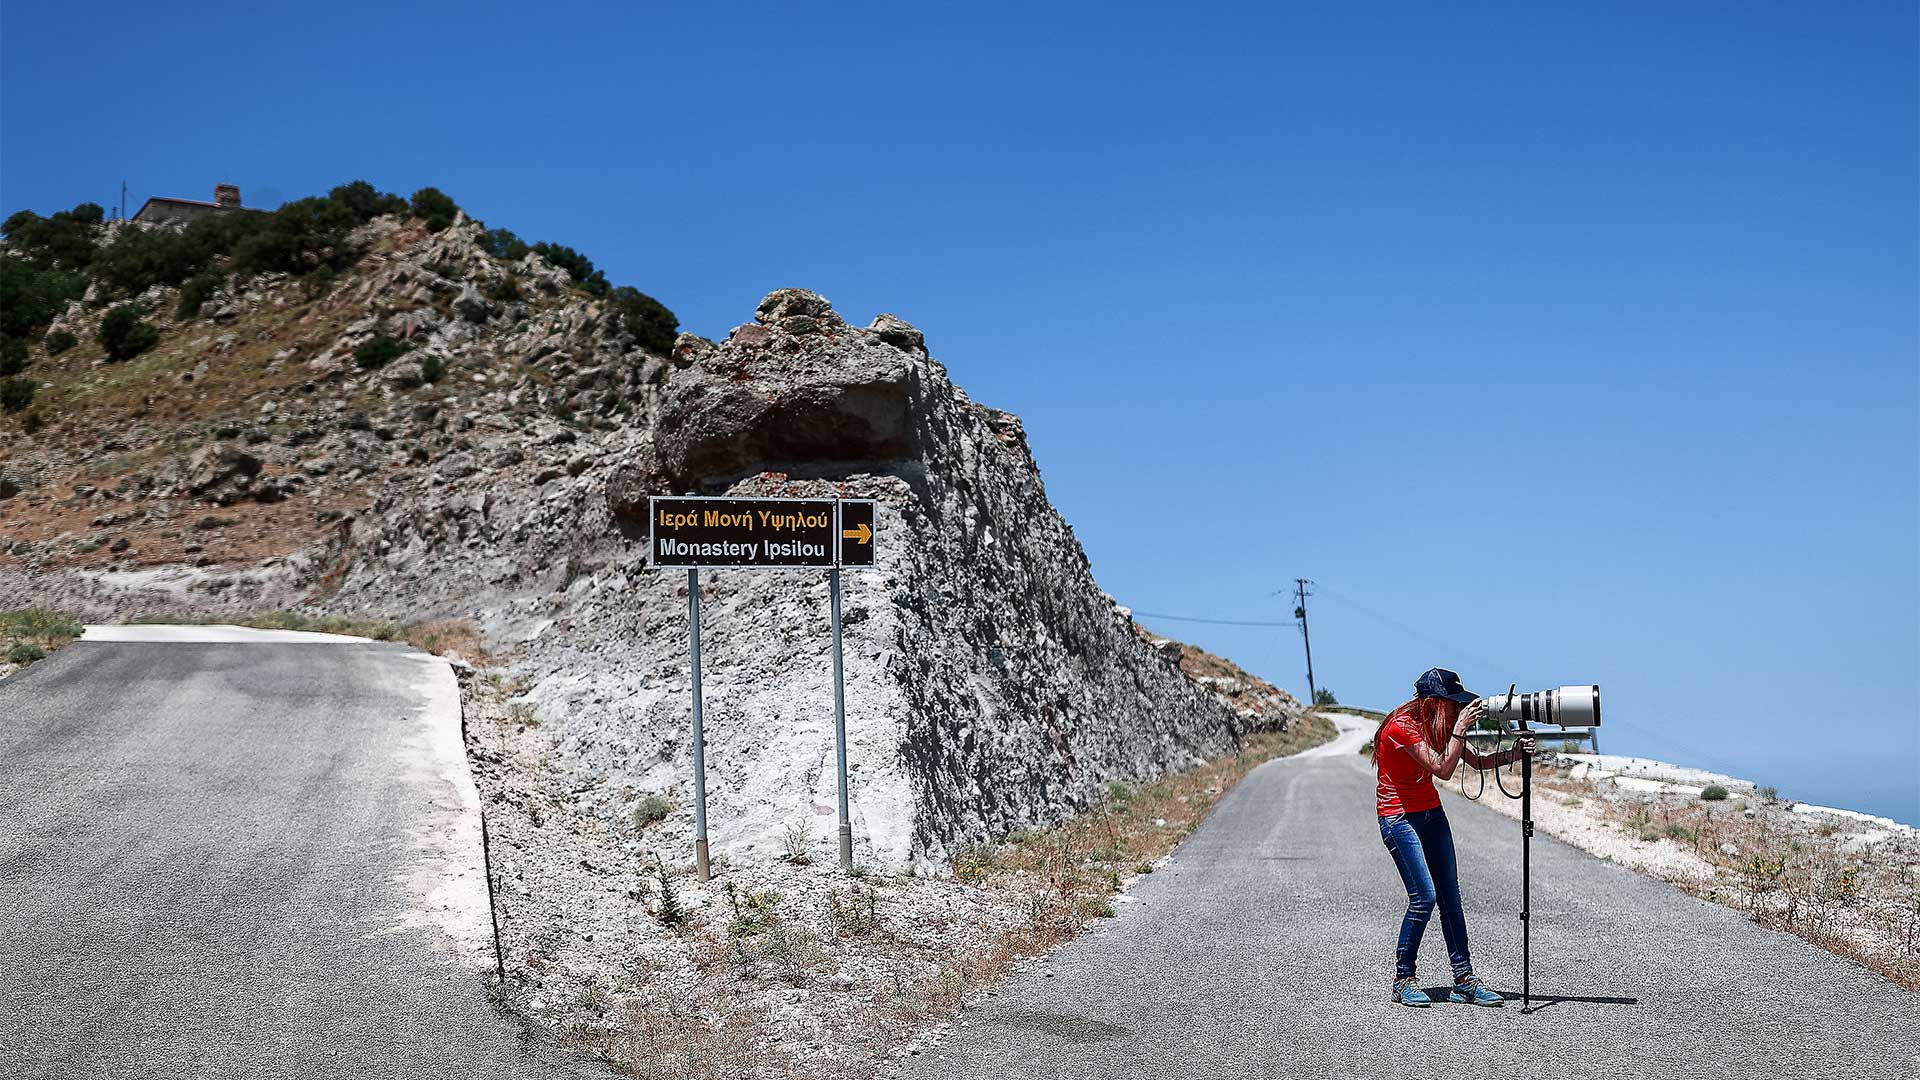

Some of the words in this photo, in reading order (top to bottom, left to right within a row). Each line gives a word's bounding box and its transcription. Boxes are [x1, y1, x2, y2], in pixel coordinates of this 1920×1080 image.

[659, 509, 698, 530] Ιερά
[704, 510, 753, 531] Μονή
[758, 510, 828, 531] Υψηλού
[660, 538, 758, 560] Monastery
[764, 539, 825, 560] Ipsilou
